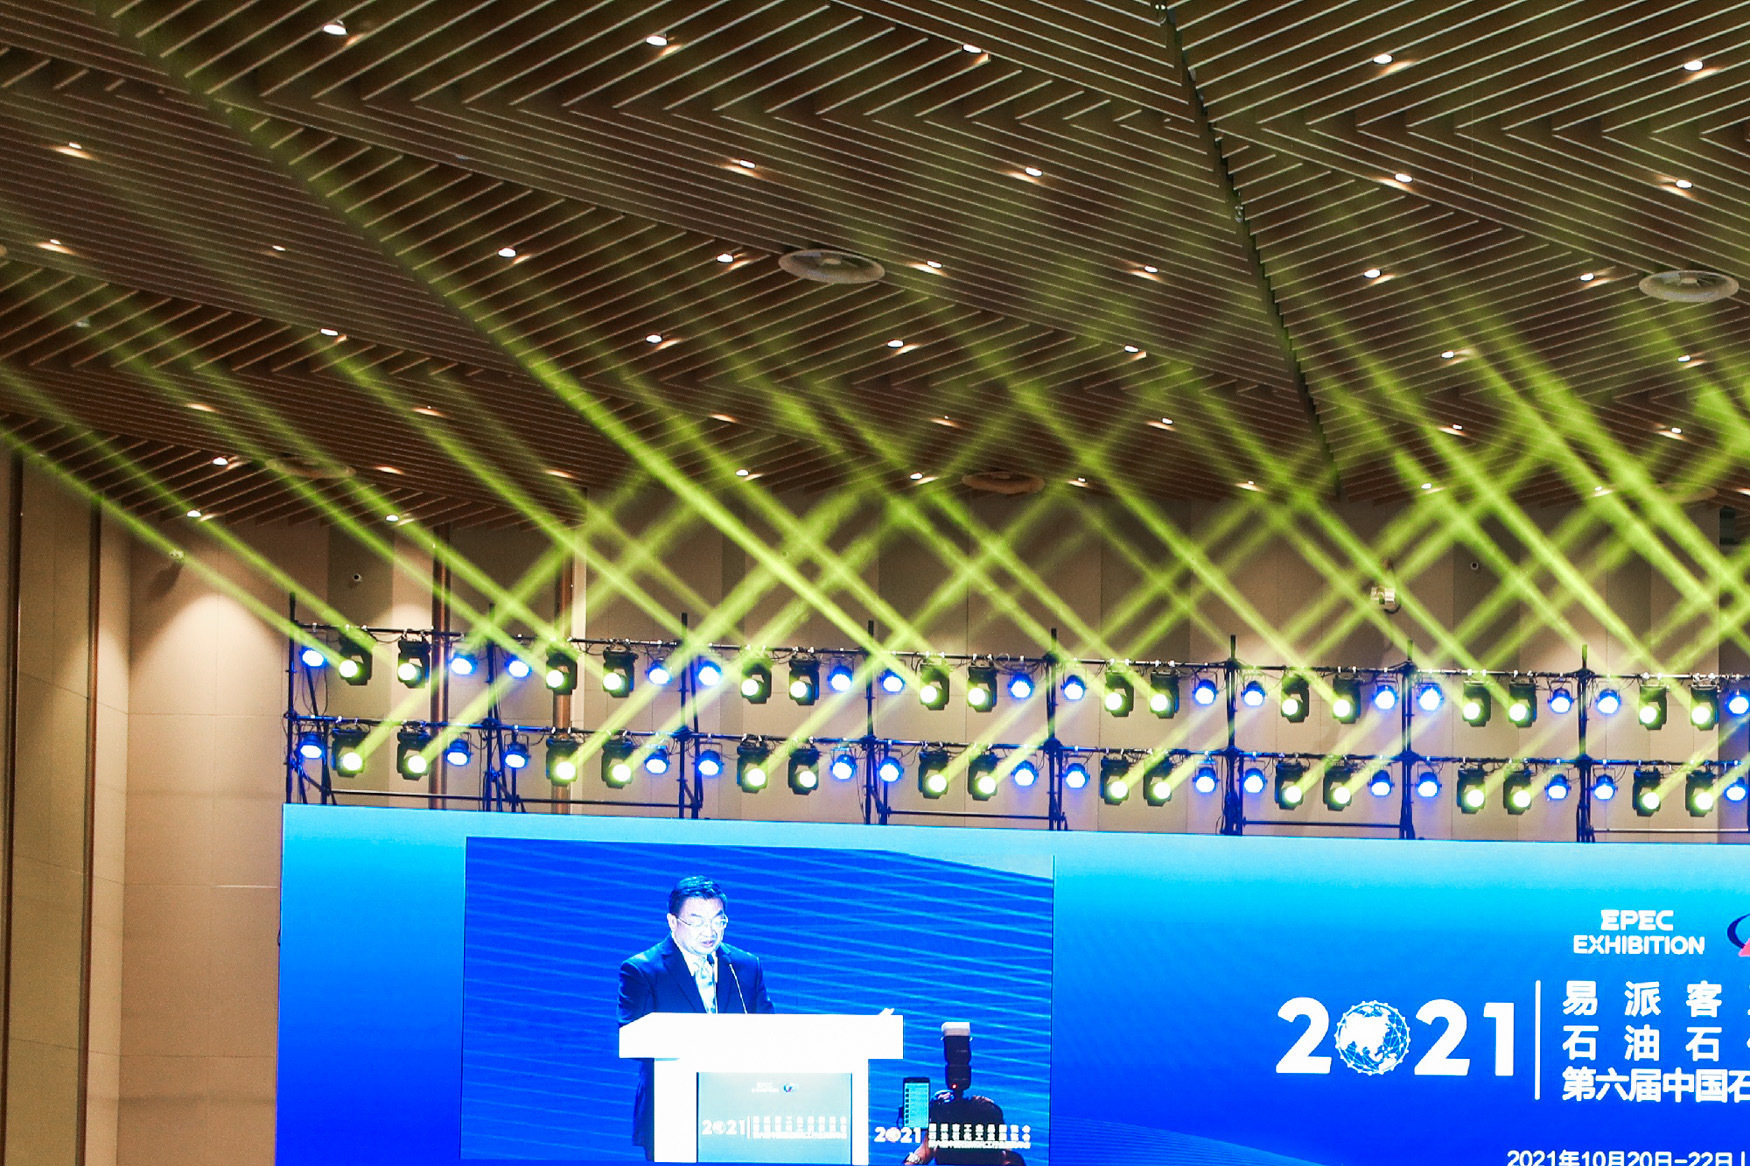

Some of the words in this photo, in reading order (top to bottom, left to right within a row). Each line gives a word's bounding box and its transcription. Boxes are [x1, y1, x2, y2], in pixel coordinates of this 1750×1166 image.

[1600, 909, 1674, 931] EPEC
[1573, 934, 1706, 956] EXHIBITION
[1275, 996, 1515, 1078] 2021
